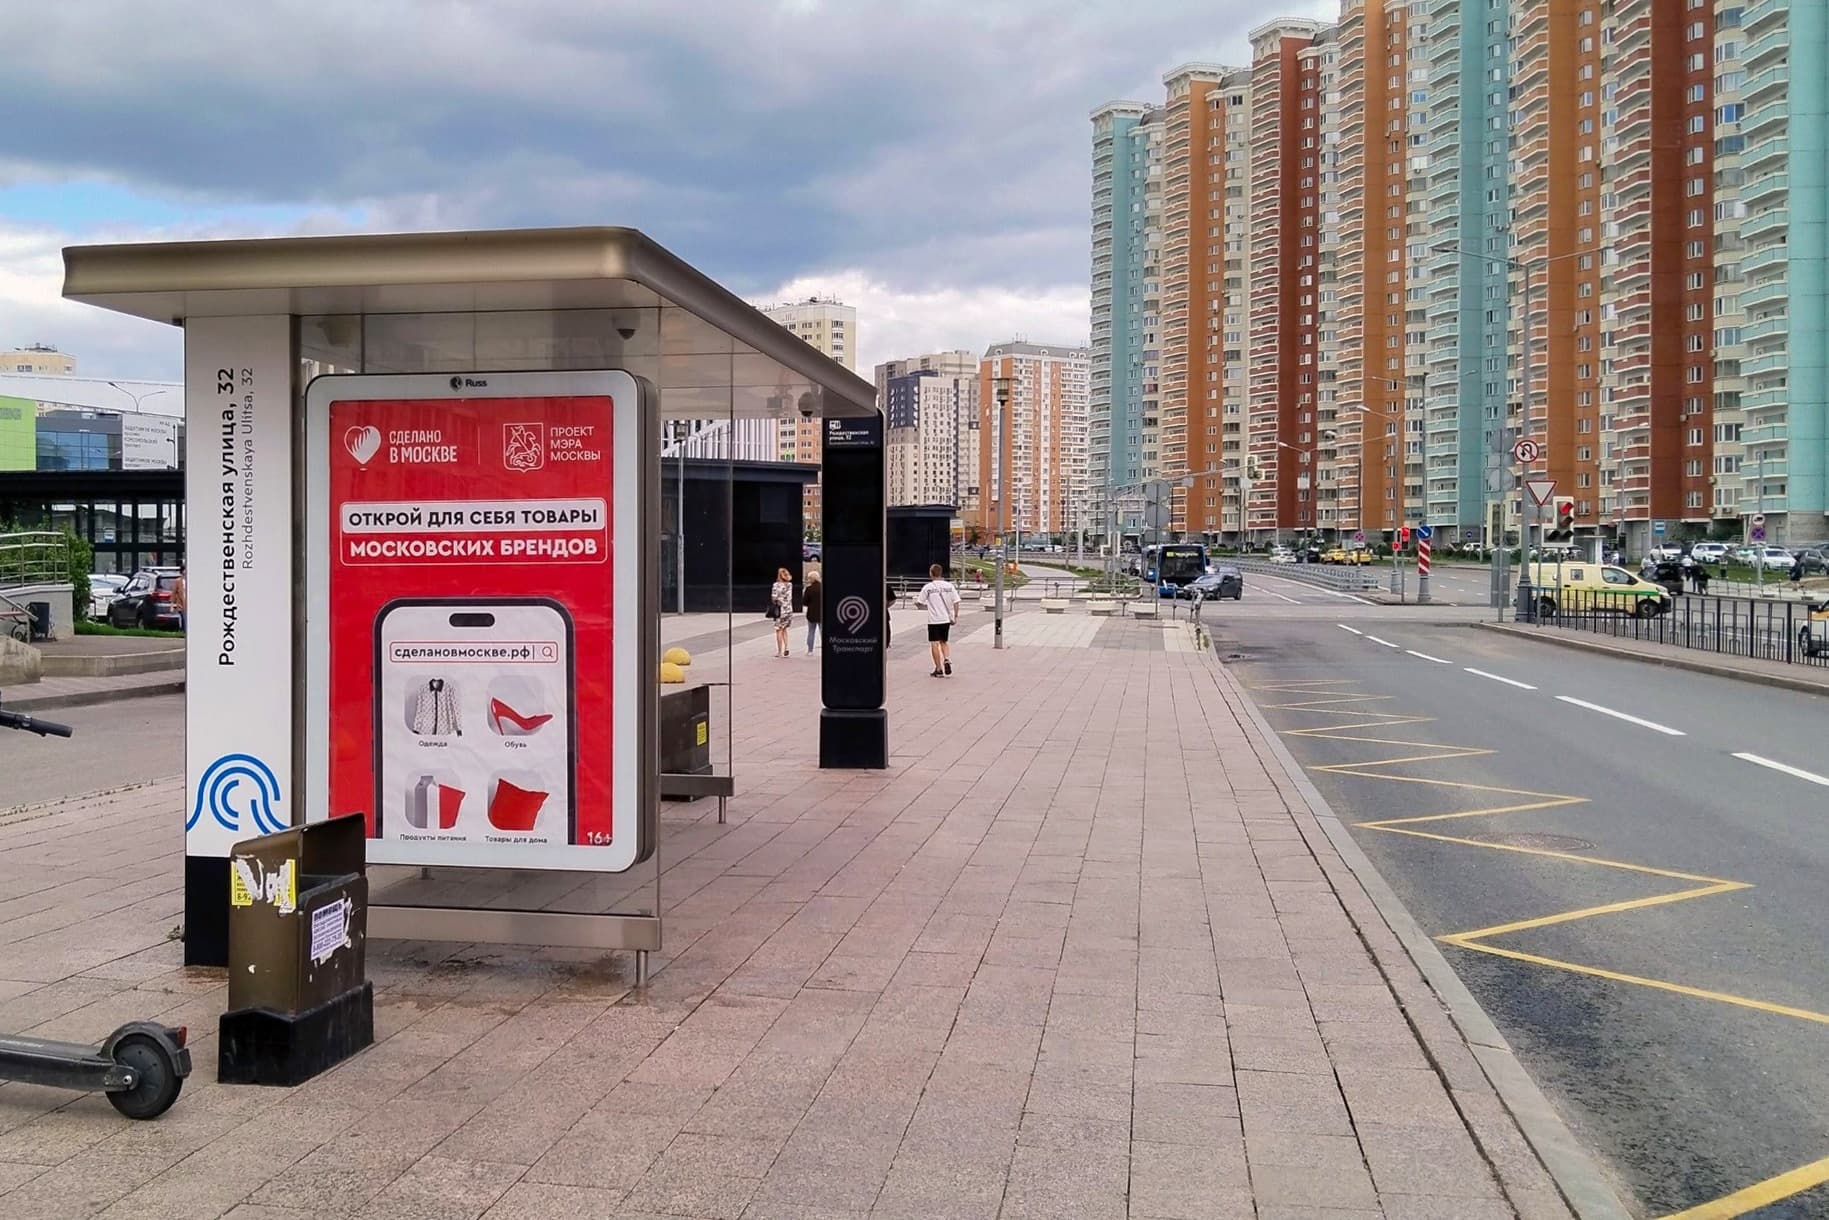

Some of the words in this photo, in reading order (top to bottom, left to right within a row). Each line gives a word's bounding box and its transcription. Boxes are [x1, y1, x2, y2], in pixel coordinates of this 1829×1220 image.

[218, 368, 234, 394] 32
[241, 368, 253, 386] 32
[465, 378, 487, 388] Russ
[241, 391, 254, 434] Ulitsa,
[389, 430, 441, 445] СДЕЛАНО
[550, 426, 594, 437] ПРОЕКТ
[222, 403, 238, 476] улица,
[550, 438, 582, 449] МЭРА
[390, 449, 399, 463] В
[401, 446, 457, 463] МОСКВЕ
[550, 450, 601, 462] МОСКВЫ
[241, 439, 255, 569] Rozhdestvenskaya
[349, 507, 422, 527] ОТКРОЙ
[428, 510, 464, 528] ДЛЯ
[470, 510, 515, 525] СЕБЯ
[522, 508, 597, 524] ТОВАРЫ
[350, 539, 494, 557] МОСКОВСКИХ
[500, 538, 598, 557] БРЕНДОВ
[218, 482, 237, 665] Рождественская
[394, 645, 531, 660] сделановмоскве.рф
[418, 740, 447, 748] Одежда
[504, 740, 527, 749] Обувь
[400, 833, 436, 841] Продукты
[485, 835, 512, 844] Товары
[586, 831, 613, 844] 16+
